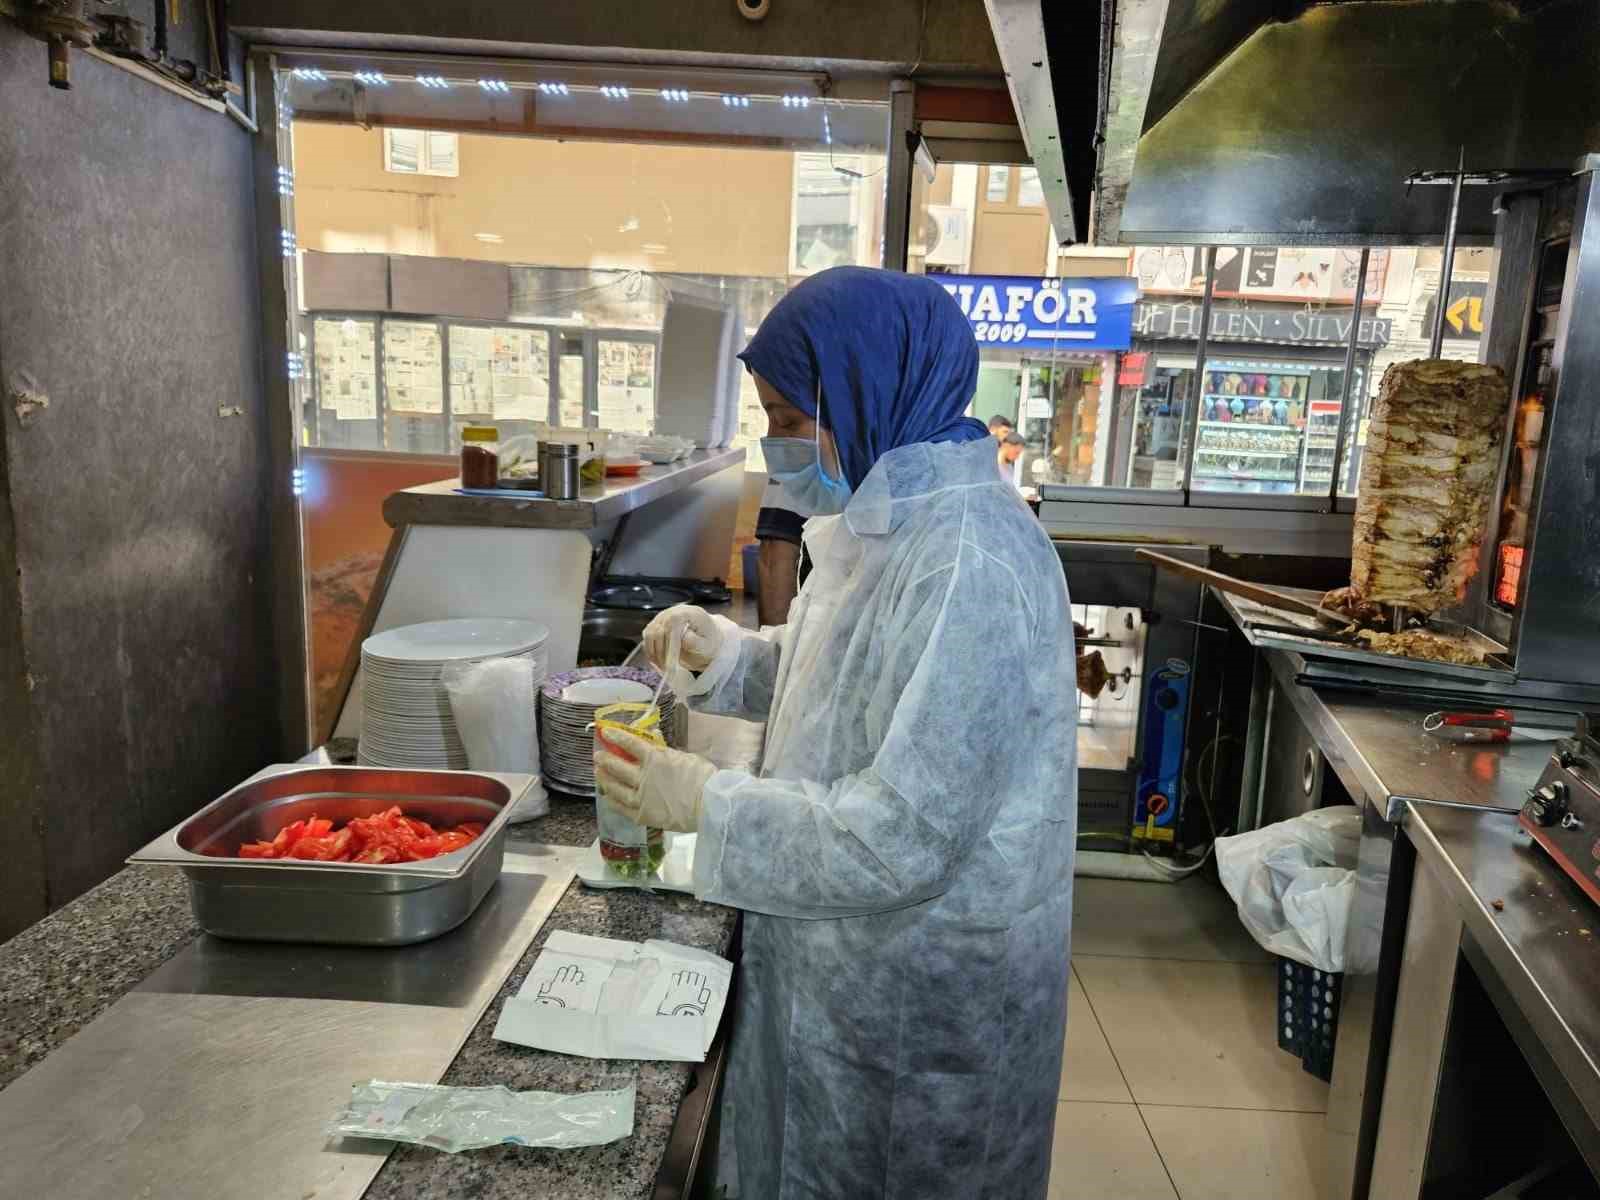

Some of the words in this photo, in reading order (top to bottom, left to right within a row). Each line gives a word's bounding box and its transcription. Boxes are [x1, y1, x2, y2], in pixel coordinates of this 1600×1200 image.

[975, 322, 1028, 343] 2009
[1167, 303, 1263, 337] HLEN
[1289, 311, 1389, 343] SILVER
